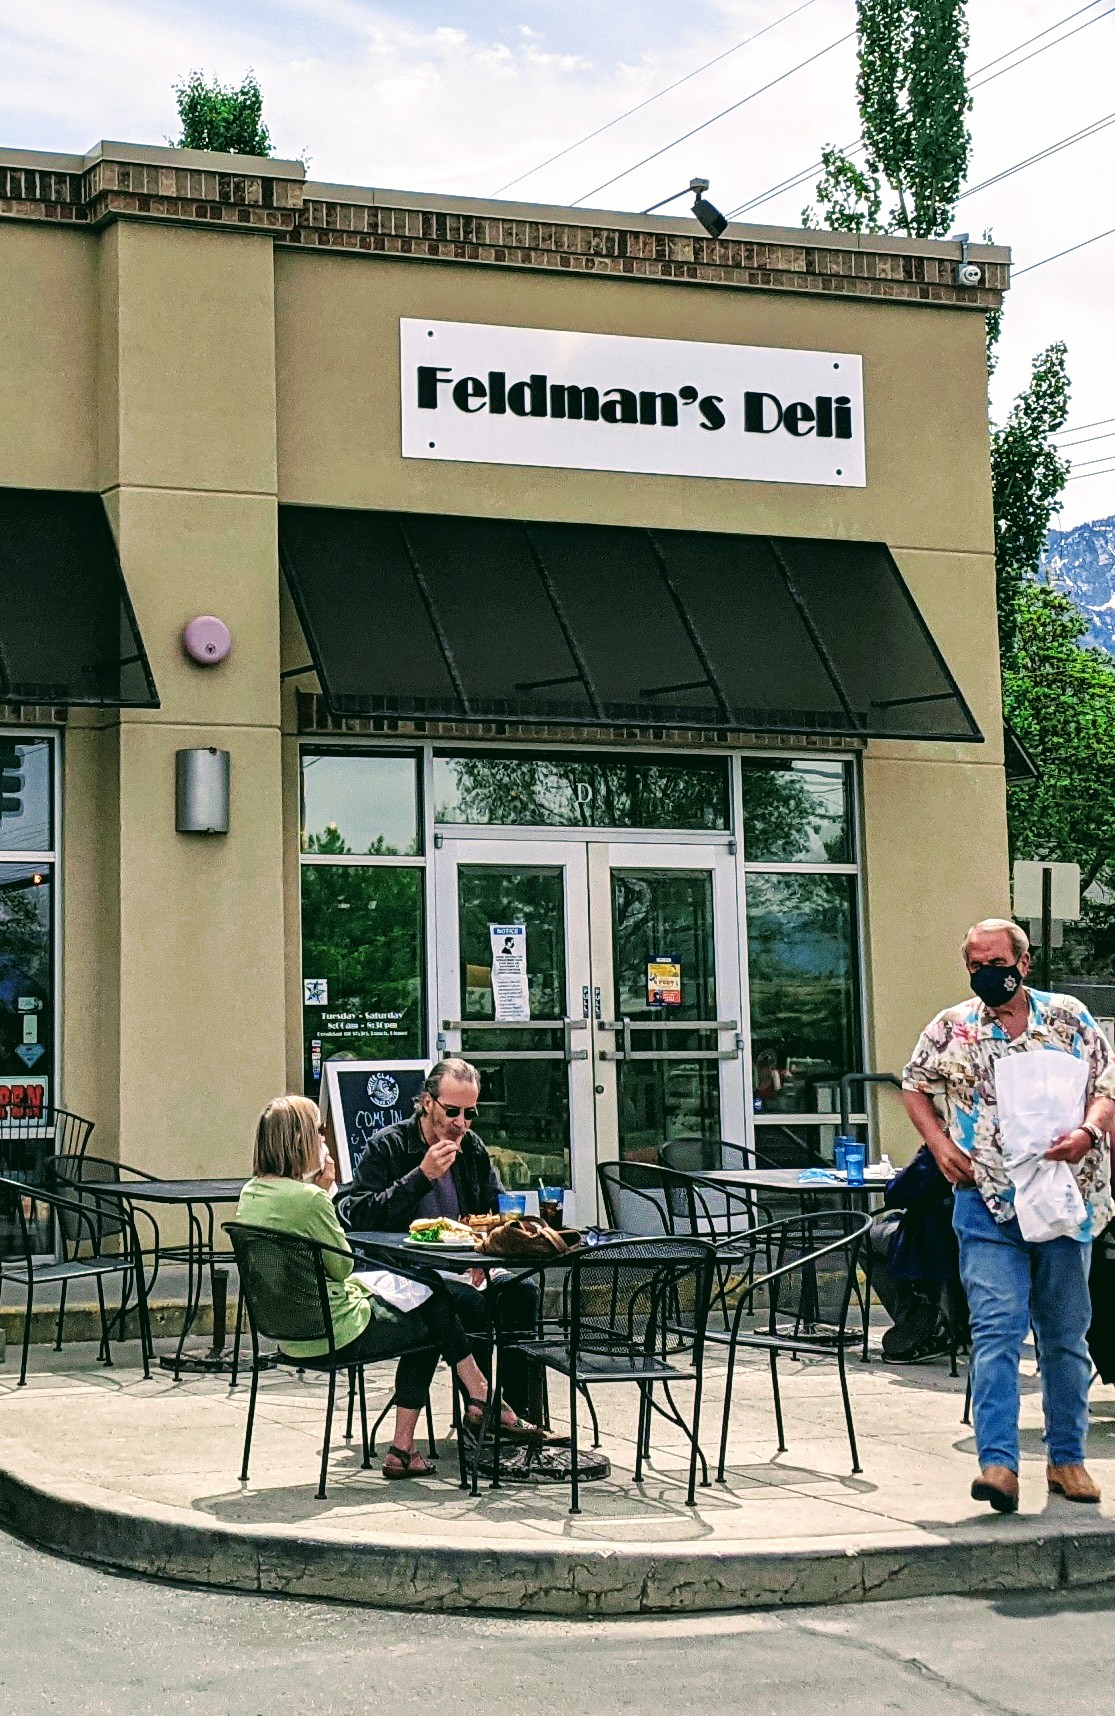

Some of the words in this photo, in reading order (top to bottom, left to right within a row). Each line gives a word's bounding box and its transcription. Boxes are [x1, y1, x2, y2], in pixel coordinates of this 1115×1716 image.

[417, 366, 726, 431] Feldman's
[744, 391, 853, 439] Deli
[576, 782, 593, 803] D
[320, 1012, 356, 1020] Tuesday
[366, 1011, 402, 1020] Saturday
[0, 1085, 44, 1119] PEN
[355, 1110, 386, 1129] COME
[390, 1109, 403, 1126] IN
